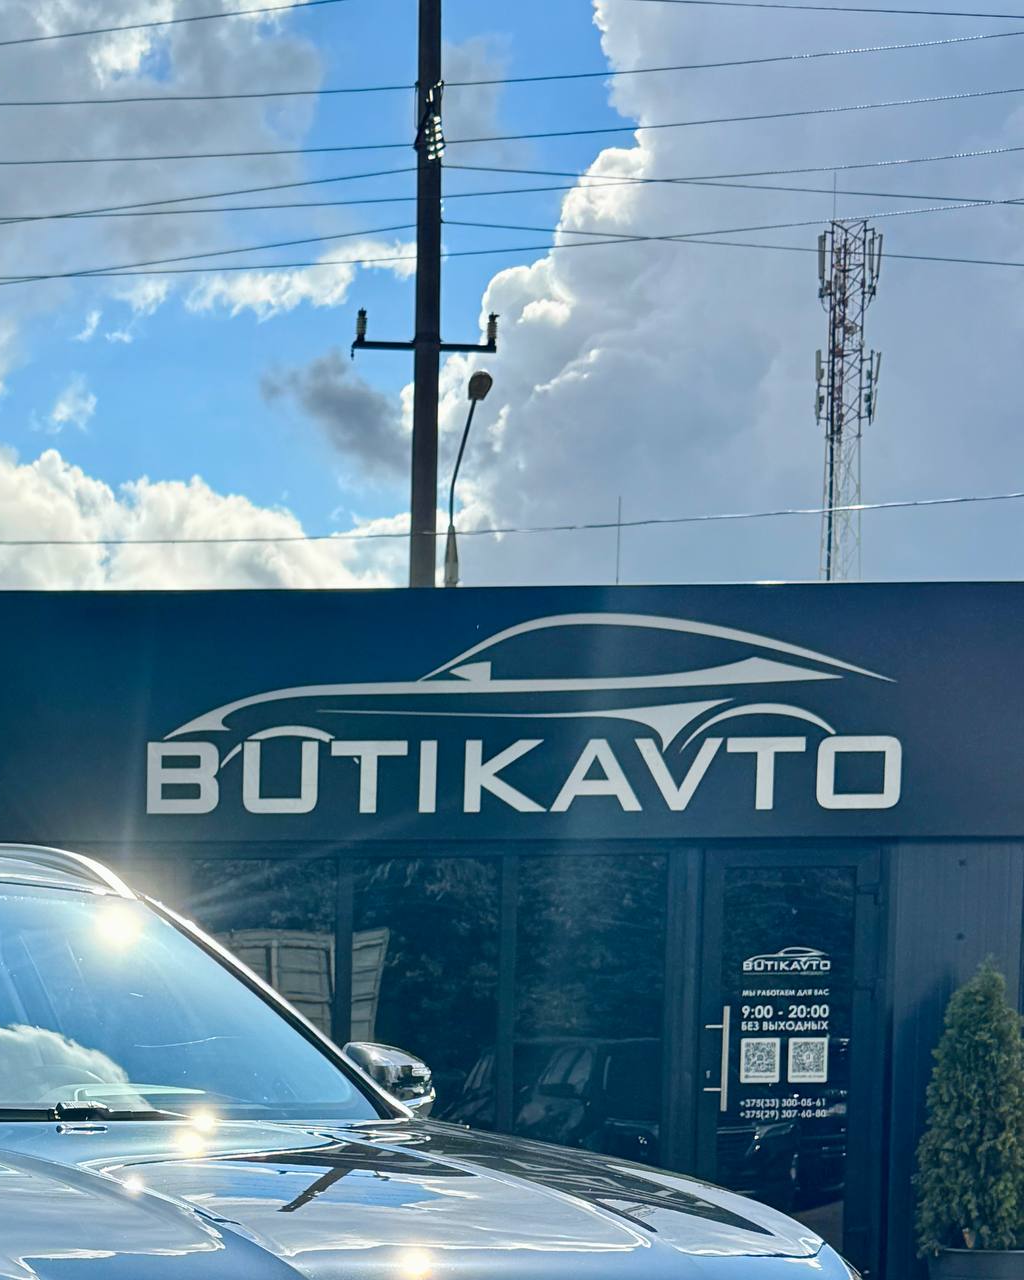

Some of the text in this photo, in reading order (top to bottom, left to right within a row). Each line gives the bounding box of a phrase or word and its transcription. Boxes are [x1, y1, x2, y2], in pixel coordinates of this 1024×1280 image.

[146, 734, 903, 815] BUTIKAVTO
[742, 959, 831, 972] BUTIKAVTO
[742, 988, 830, 997] МЫ РАБОТАЕМ ДЛЯ ВАС
[741, 1004, 774, 1019] 9:00
[788, 1003, 830, 1018] 20:00
[740, 1020, 829, 1031] БЕЗ ВЫХОДНЫХ
